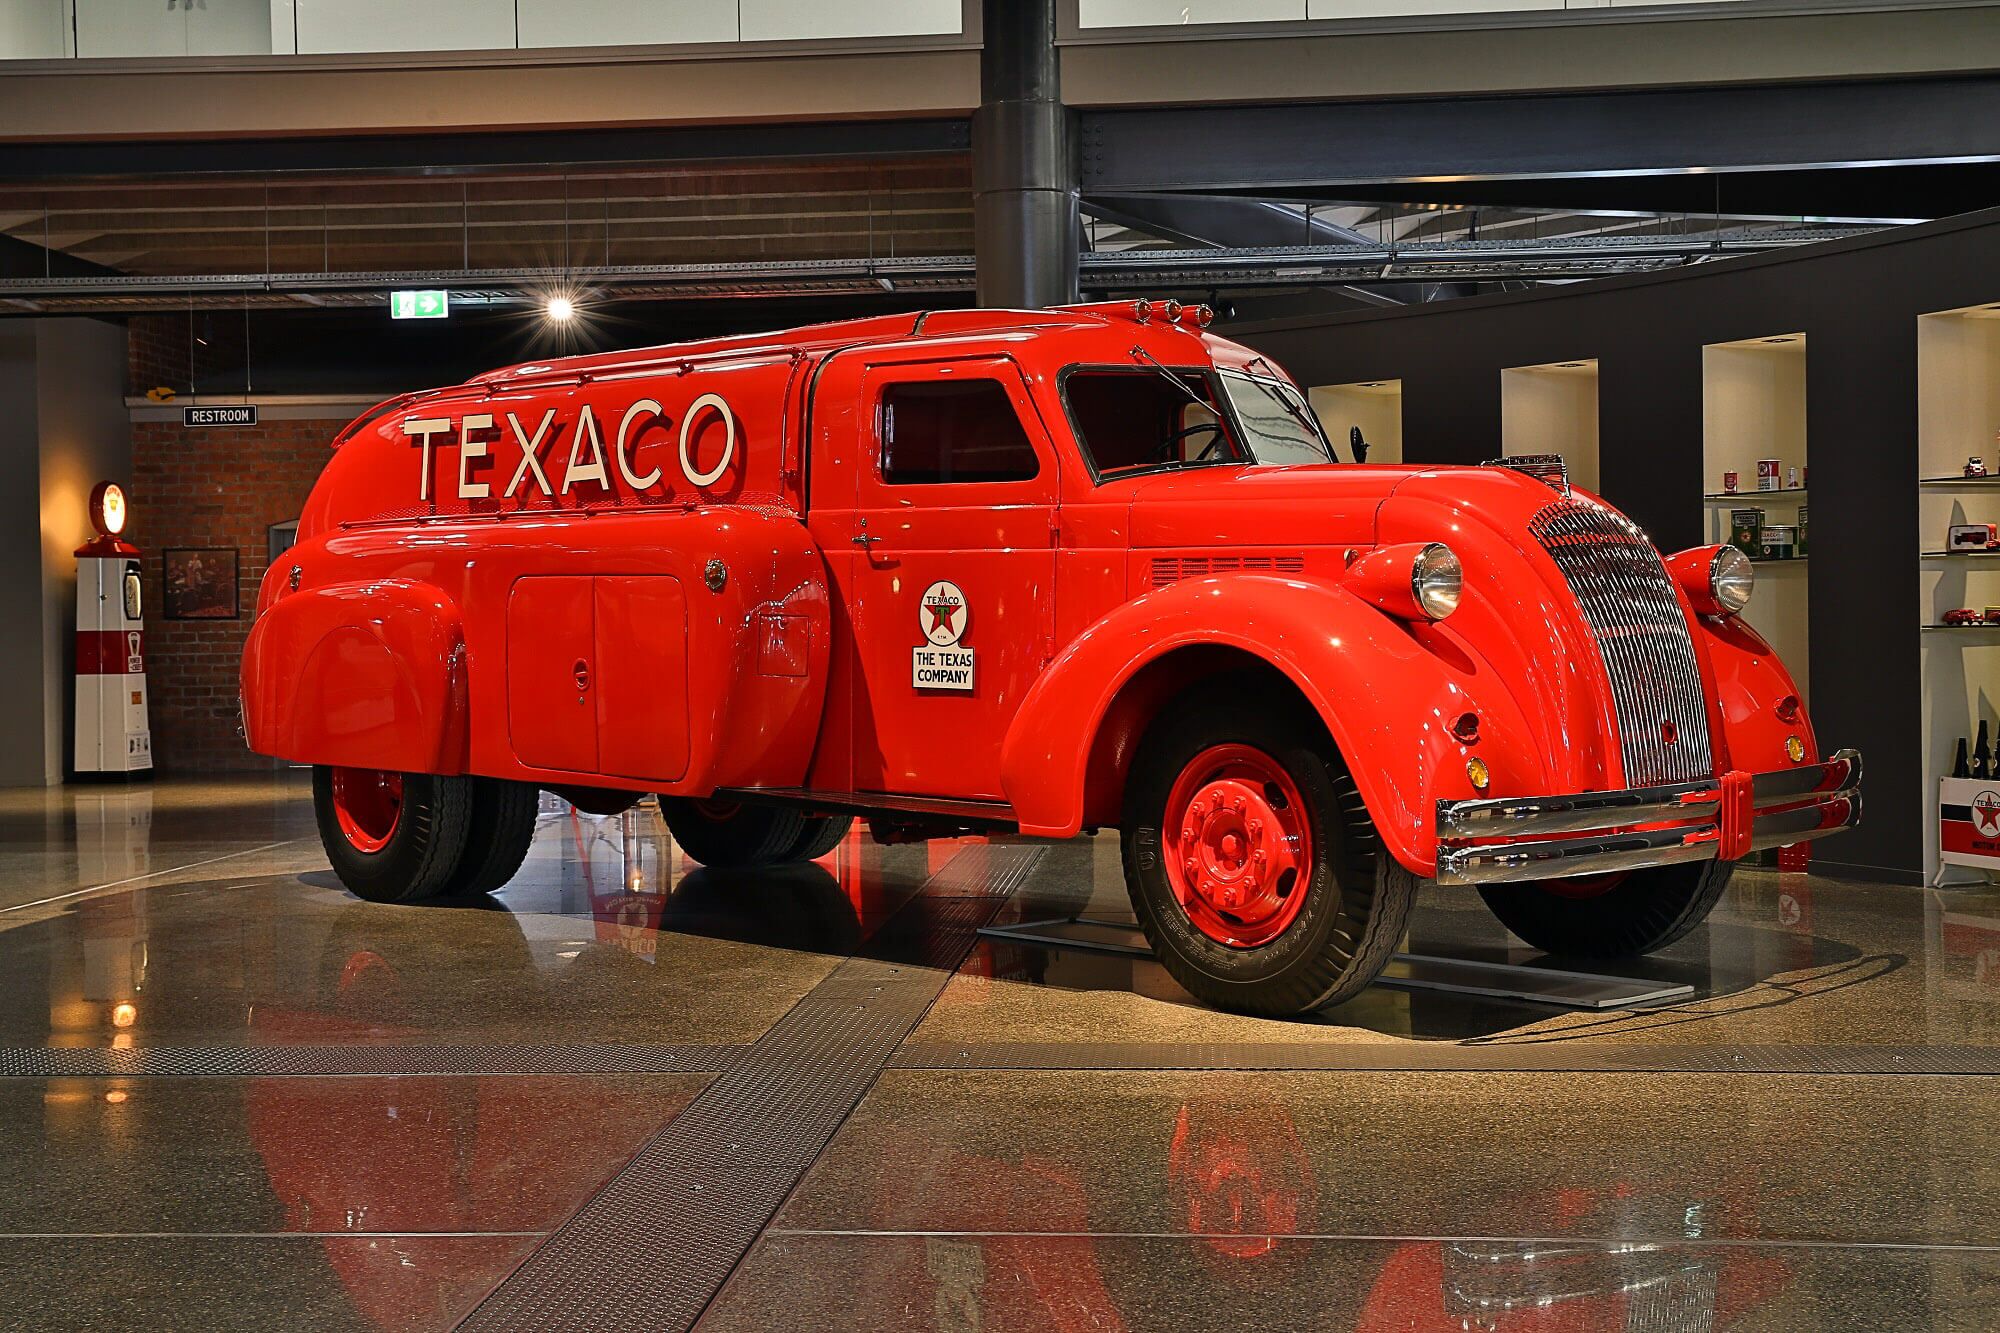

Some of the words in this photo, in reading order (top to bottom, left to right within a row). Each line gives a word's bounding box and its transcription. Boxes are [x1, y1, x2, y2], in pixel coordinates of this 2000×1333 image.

[192, 409, 249, 423] RESTROOM
[403, 392, 735, 500] TEXACO
[926, 596, 960, 605] TEXACO
[916, 652, 936, 666] THE
[939, 652, 972, 667] TEXAS
[917, 668, 969, 684] COMPANY
